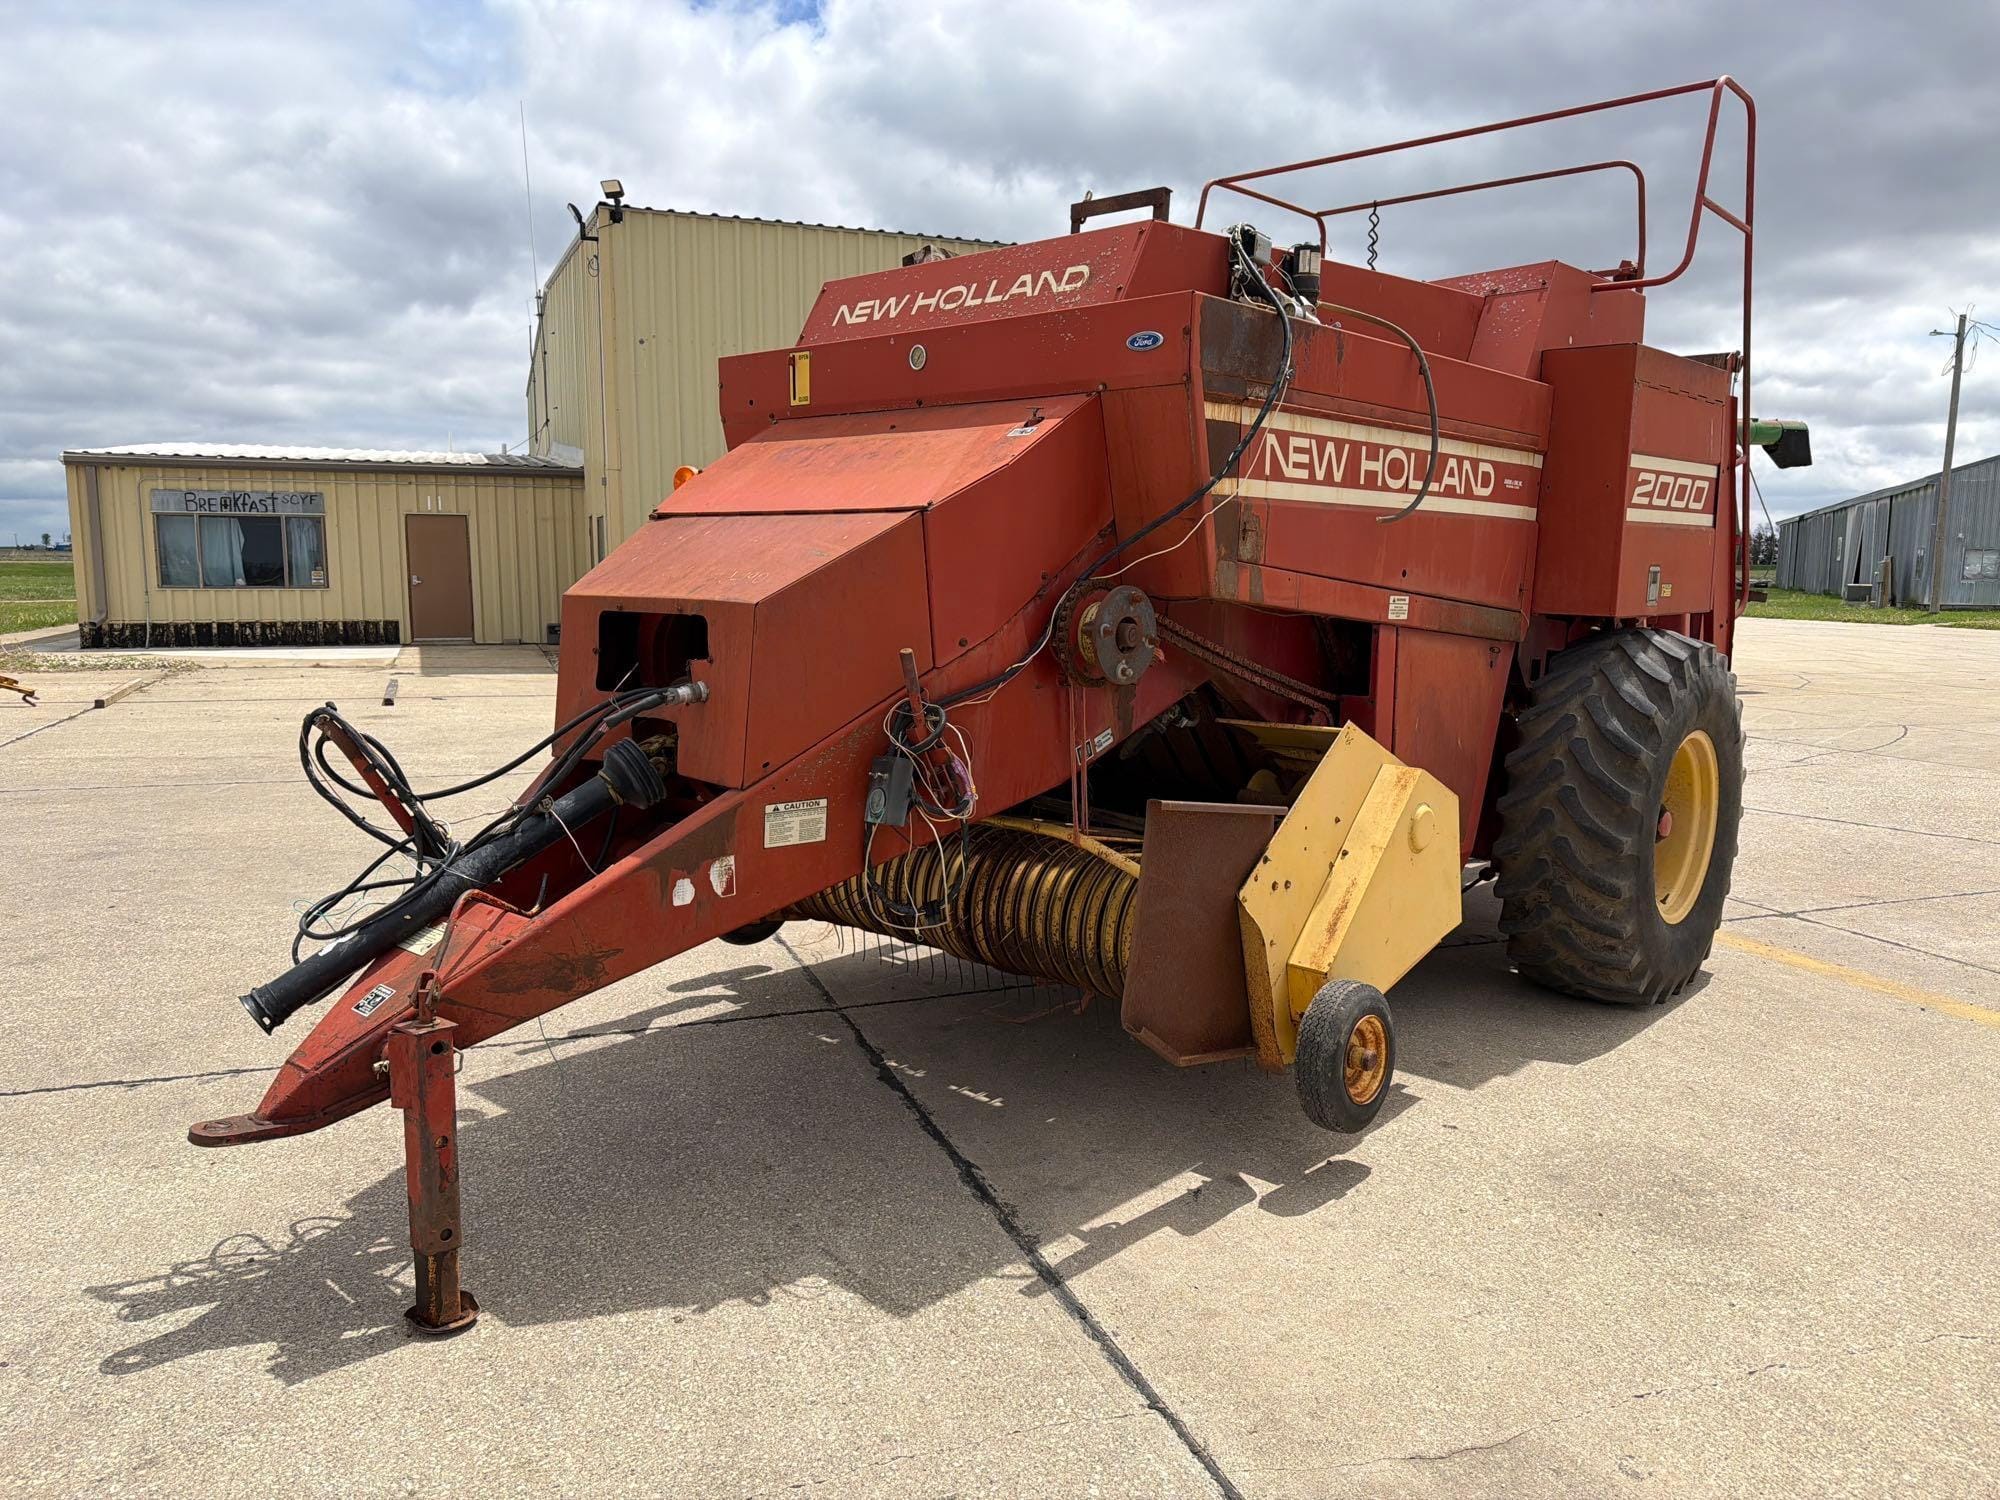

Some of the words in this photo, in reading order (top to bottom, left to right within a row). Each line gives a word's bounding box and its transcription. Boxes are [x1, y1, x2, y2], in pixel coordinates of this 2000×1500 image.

[832, 294, 910, 327] NEW
[911, 264, 1090, 315] HOLLAND
[1264, 433, 1350, 483] NEW
[1360, 445, 1495, 497] HOLLAND
[1631, 471, 1710, 510] 2000
[783, 800, 821, 811] CAUTION
